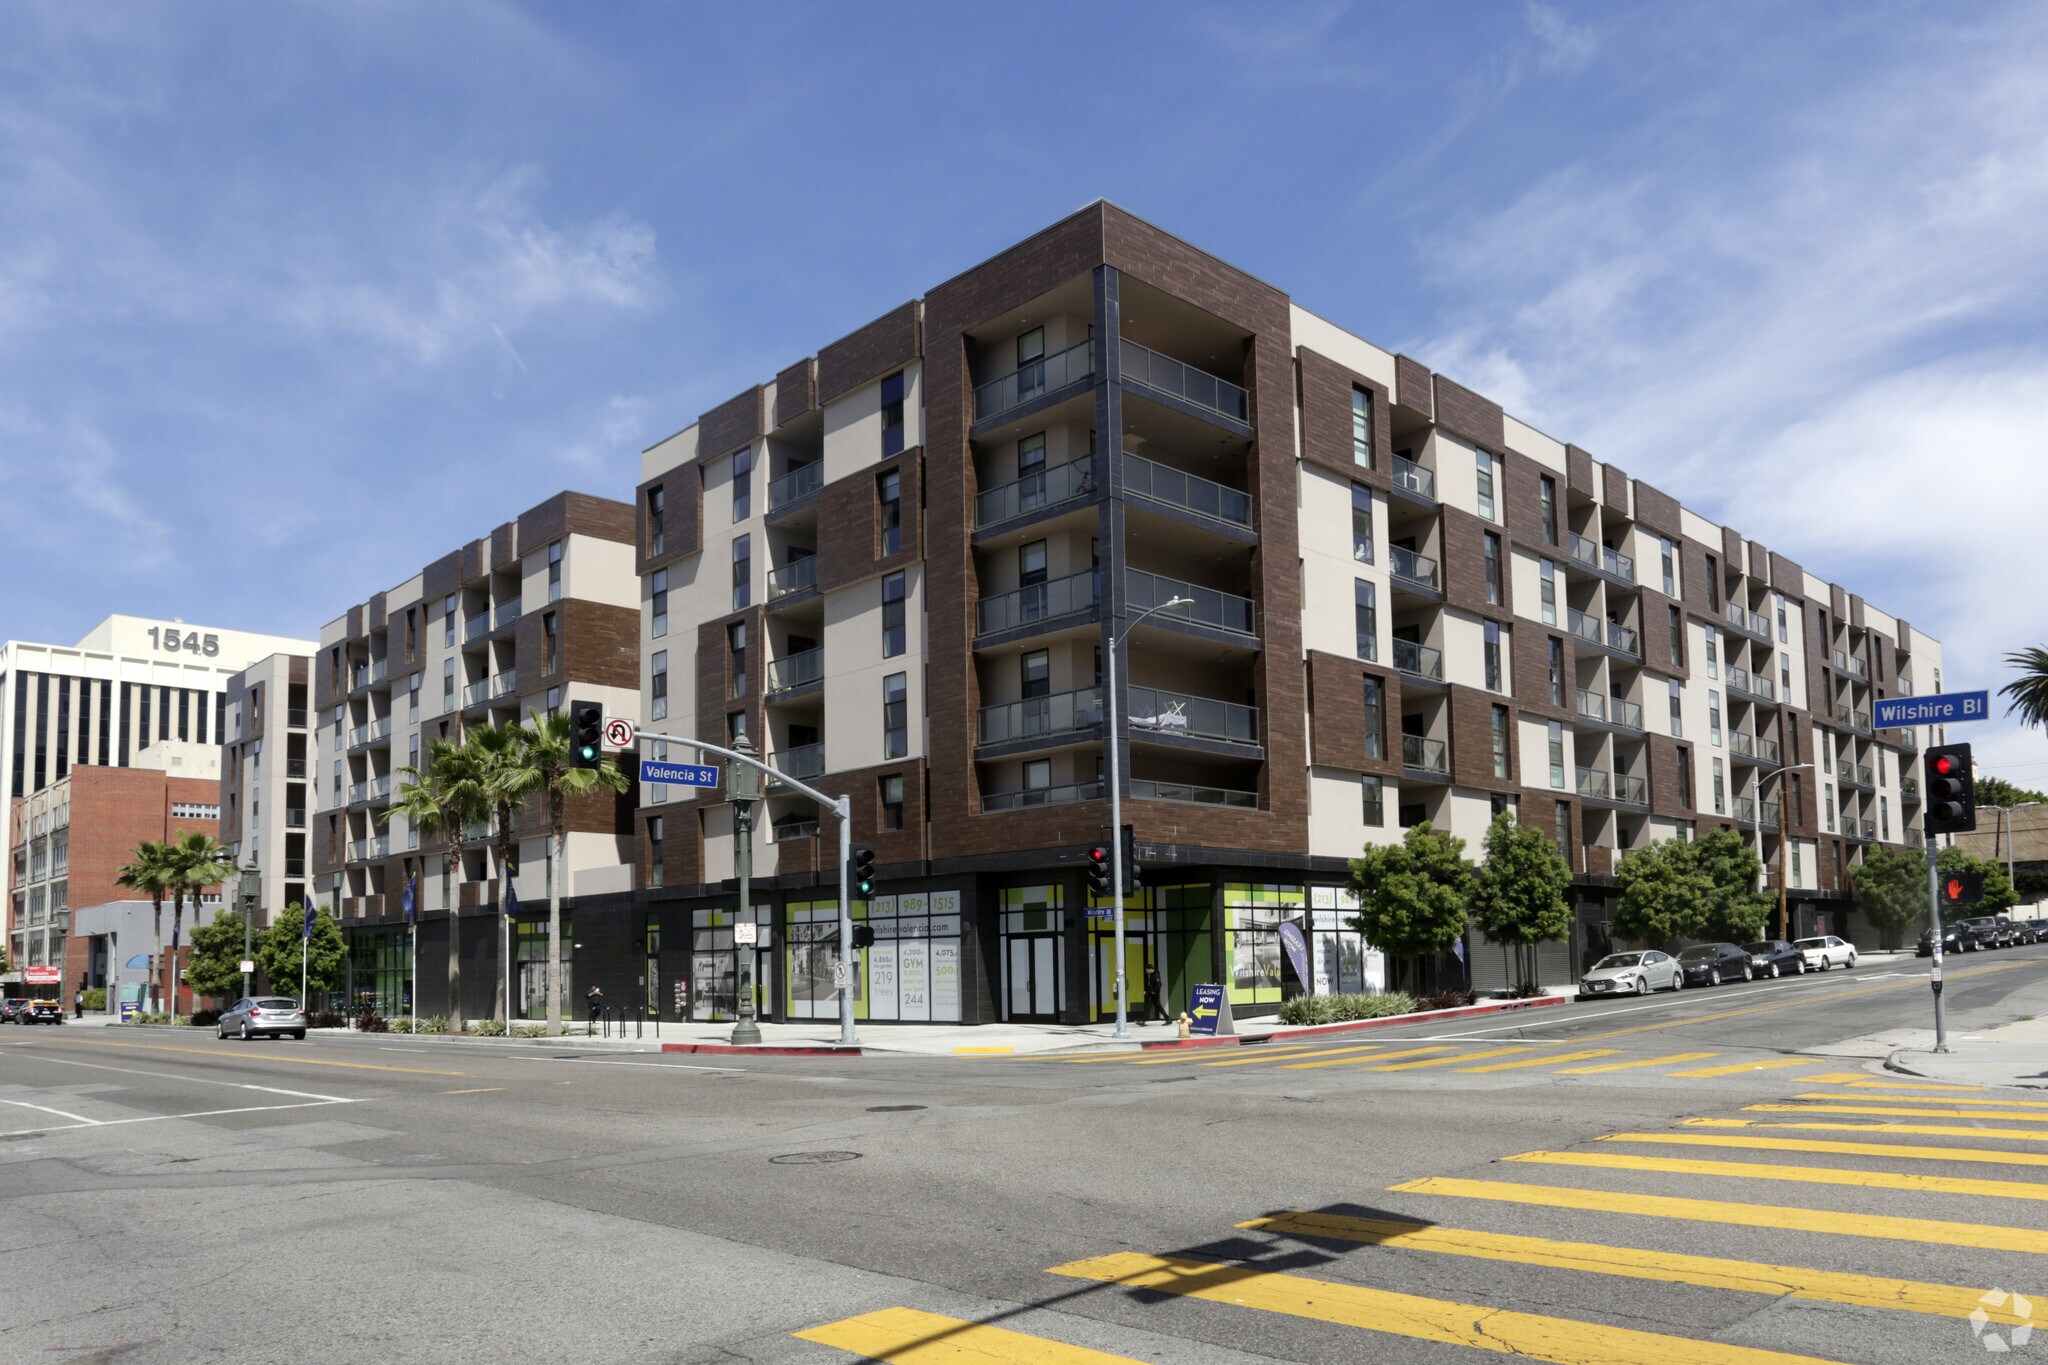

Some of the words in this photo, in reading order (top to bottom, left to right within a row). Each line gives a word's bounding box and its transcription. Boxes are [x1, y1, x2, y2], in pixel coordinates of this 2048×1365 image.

[147, 626, 219, 657] 1545
[1881, 702, 1954, 721] Wilshire
[1963, 698, 1981, 714] Bl
[646, 766, 695, 781] Valencia
[699, 771, 713, 782] St
[871, 898, 895, 914] (213)
[903, 958, 923, 969] GYM
[874, 971, 893, 985] 219
[1316, 978, 1334, 986] NOW
[874, 987, 893, 996] trees
[905, 993, 923, 1005] 244
